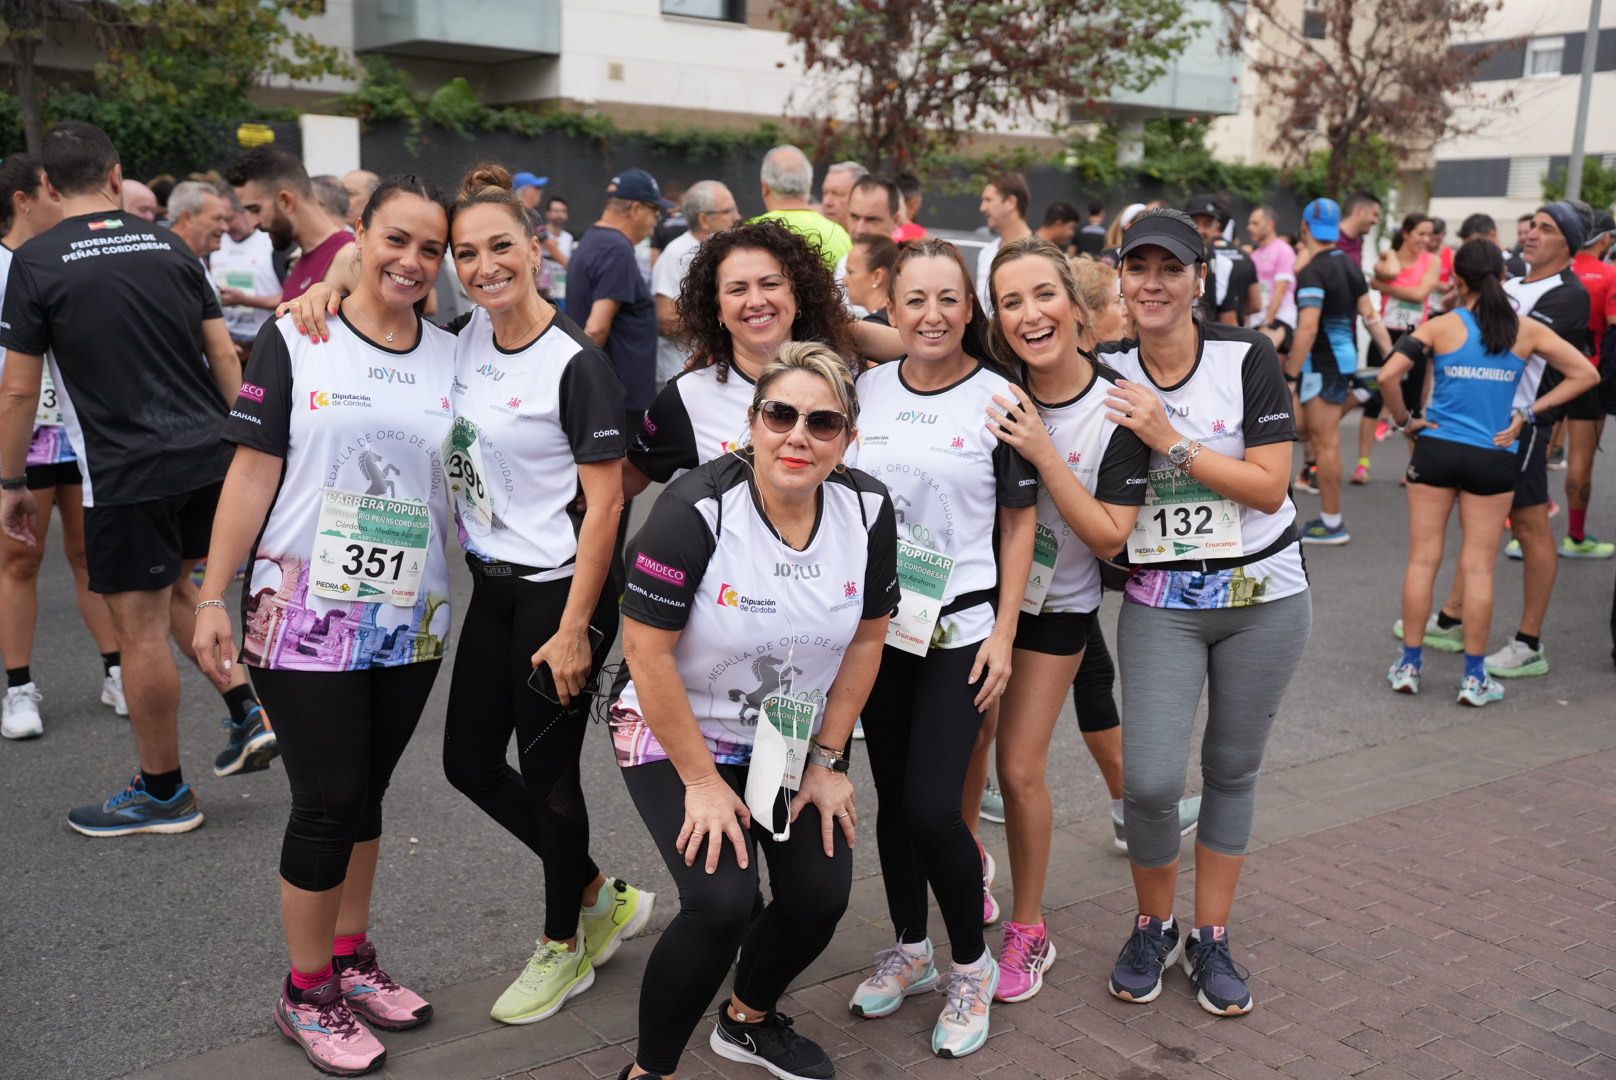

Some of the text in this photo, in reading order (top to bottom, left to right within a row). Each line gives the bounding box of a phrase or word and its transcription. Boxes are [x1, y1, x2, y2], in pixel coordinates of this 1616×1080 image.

[70, 233, 157, 250] FEDERACIÓN DE
[61, 242, 171, 263] PEÑAS CORDOBESAS
[368, 366, 416, 385] JOYLU
[332, 393, 371, 401] Diputación
[895, 410, 939, 424] JOYLU
[357, 433, 372, 447] DE
[376, 430, 405, 441] ORO
[409, 434, 426, 448] DE
[493, 450, 514, 493] CIUDAD
[327, 490, 385, 511] CARRERA
[886, 463, 910, 473] ORO
[938, 492, 954, 536] CIUDAD
[1153, 505, 1214, 538] 132
[342, 543, 405, 581] 351
[898, 545, 952, 570] POPULAR
[644, 558, 684, 580] IMDECO
[903, 562, 949, 581] CORDOBESAS
[316, 580, 339, 590] PIEDRA
[908, 573, 936, 589] Azahara
[648, 593, 686, 608] AZAHARA
[895, 630, 925, 645] Cruzcampo
[708, 651, 752, 682] MEDALLA
[756, 642, 774, 654] DE
[779, 634, 810, 647] ORO
[813, 636, 831, 648] DE
